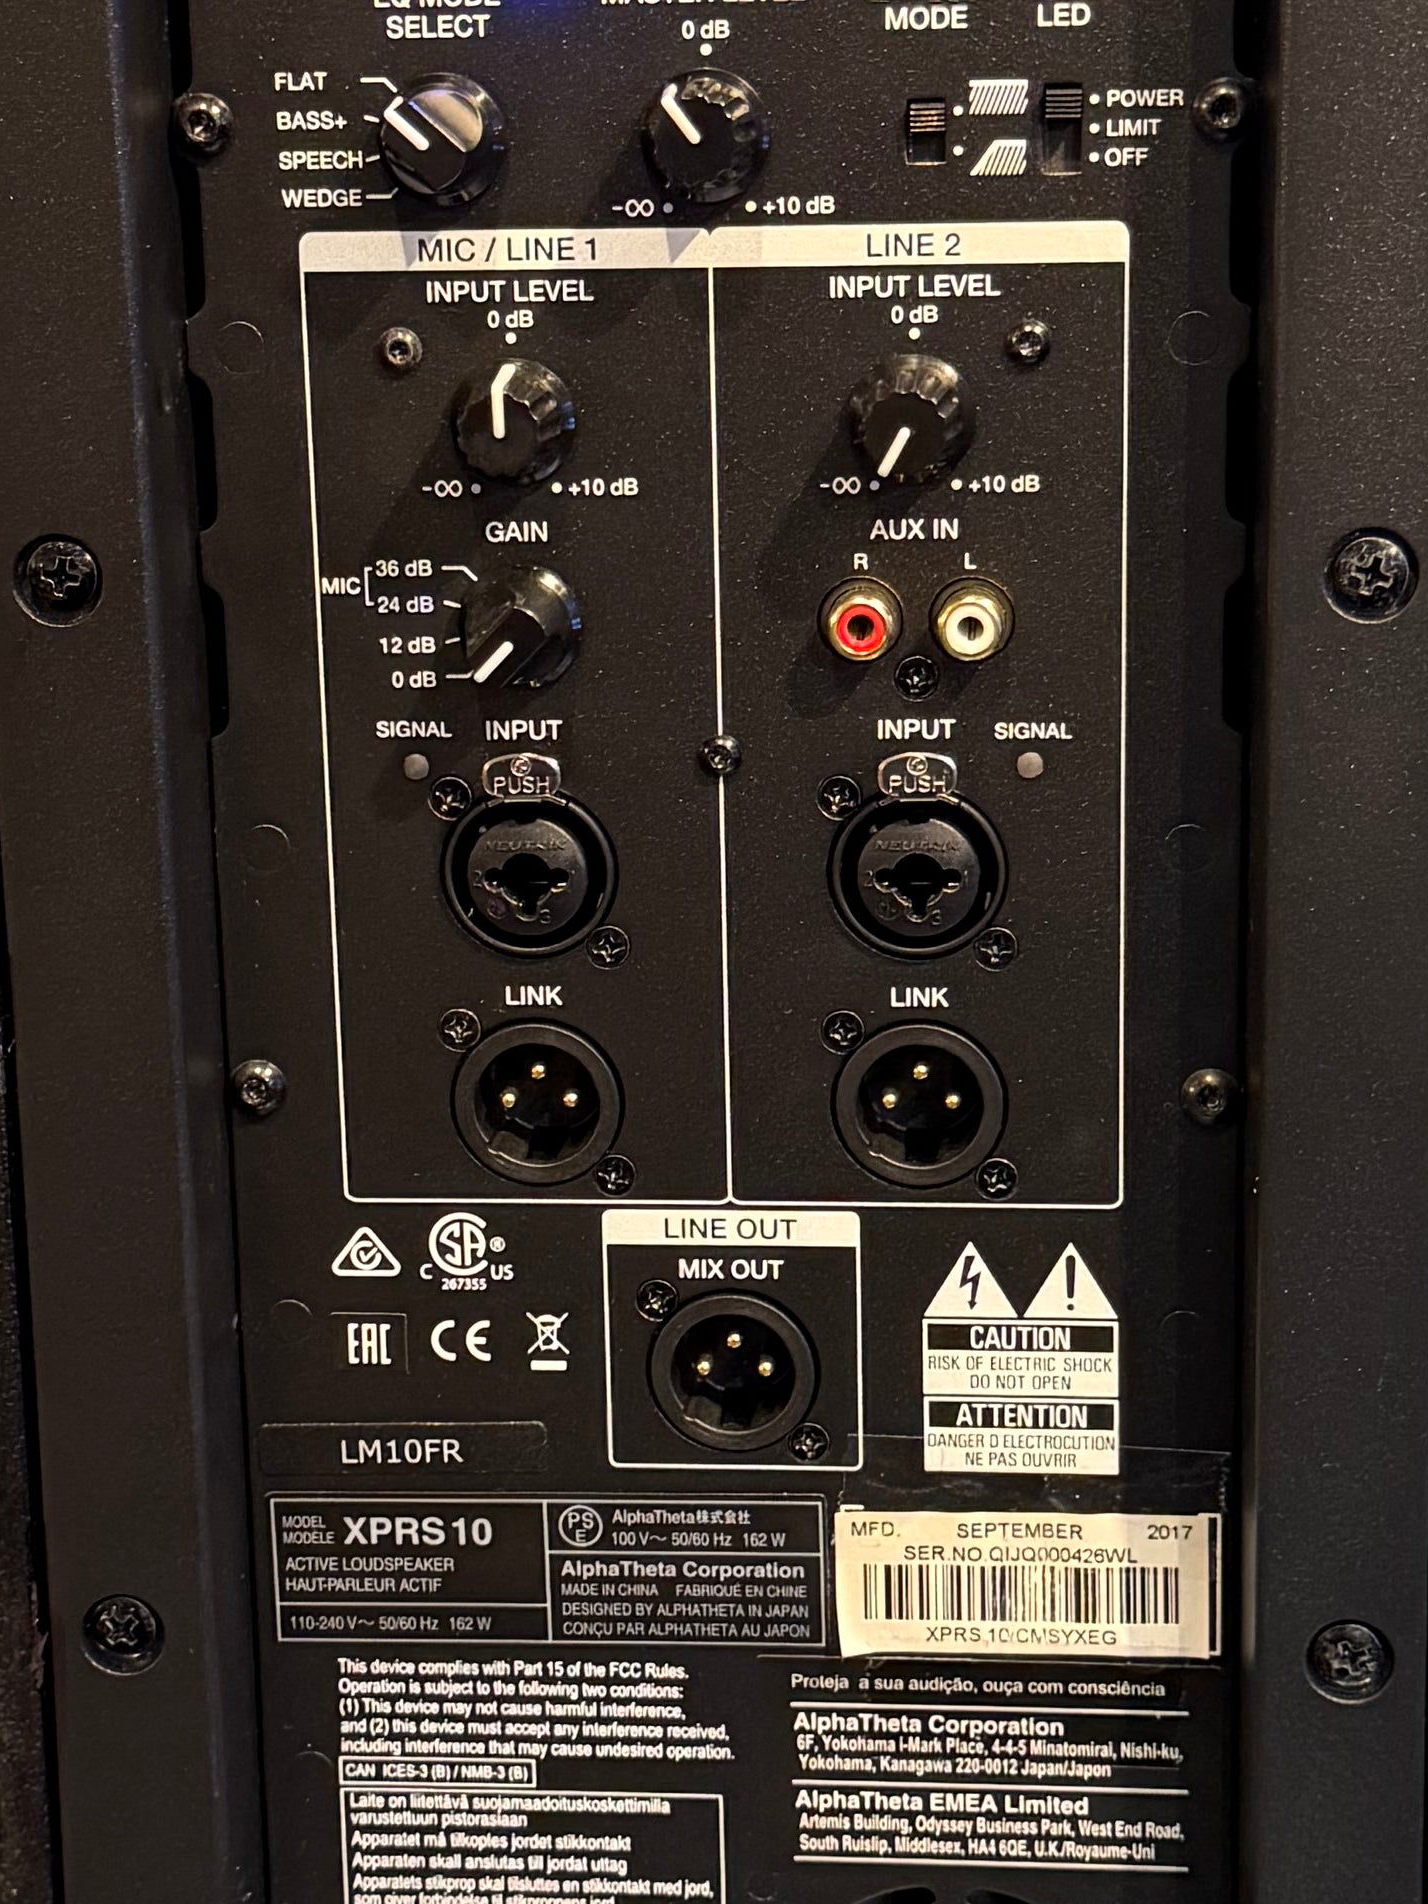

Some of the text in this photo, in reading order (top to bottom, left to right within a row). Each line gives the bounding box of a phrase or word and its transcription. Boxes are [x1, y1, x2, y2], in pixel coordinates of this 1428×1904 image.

[884, 4, 969, 31] MODE
[1037, 1, 1092, 28] LED
[386, 13, 491, 40] SELECT
[681, 19, 731, 40] 0 dB
[273, 71, 328, 92] FLAT
[1106, 88, 1184, 108] POWER
[276, 110, 348, 131] BASS+
[1106, 118, 1162, 137] LIMIT
[278, 150, 364, 171] SPEECH
[1103, 146, 1149, 167] OFF
[280, 187, 363, 209] WEDGE
[762, 194, 836, 215] +10 dB
[417, 237, 475, 262] MIC
[506, 236, 576, 262] LINE
[584, 237, 596, 261] 1
[866, 232, 961, 258] LINE 2
[426, 279, 595, 304] INPUT LEVEL
[829, 273, 1002, 299] INPUT LEVEL
[486, 309, 535, 329] 0 dB
[890, 304, 939, 324] 0 dB
[568, 477, 639, 497] +10 dB
[968, 473, 1041, 493] +10 dB
[485, 520, 548, 543] GAIN
[869, 517, 959, 541] AUX IN
[375, 558, 433, 578] 36 dB
[853, 552, 869, 571] R
[963, 552, 978, 570] L
[320, 578, 362, 597] MIC
[377, 595, 435, 614] 24 dB
[379, 635, 437, 654] 12 dB
[391, 670, 437, 689] 0 dB
[375, 719, 453, 739] SIGNAL
[485, 719, 563, 741] INPUT
[877, 718, 957, 740] INPUT
[994, 721, 1073, 740] SIGNAL
[494, 776, 551, 795] PUSH
[888, 774, 947, 794] PUSH
[505, 985, 563, 1006] LINK
[890, 986, 950, 1008] LINK
[663, 1218, 798, 1240] LINE OUT
[678, 1258, 785, 1280] MIX OUT
[969, 1325, 1072, 1351] CAUTION
[927, 1355, 1112, 1373] RISK OF ELECTRIC SHOCK
[969, 1374, 1072, 1391] DO NOT OPEN
[955, 1402, 1089, 1429] ATTENTION
[340, 1438, 464, 1464] LM10FR
[965, 1451, 1077, 1468] NE PAS OUVRIR
[343, 1516, 493, 1546] XPRS 10
[956, 1522, 1083, 1541] SEPTEMBER
[1147, 1524, 1194, 1541] 2017
[285, 1556, 455, 1572] ACTIVE LOUDSPEAKER
[560, 1559, 805, 1581] AlphaTheta Corporation
[560, 1582, 659, 1597] MADE IN CHINA
